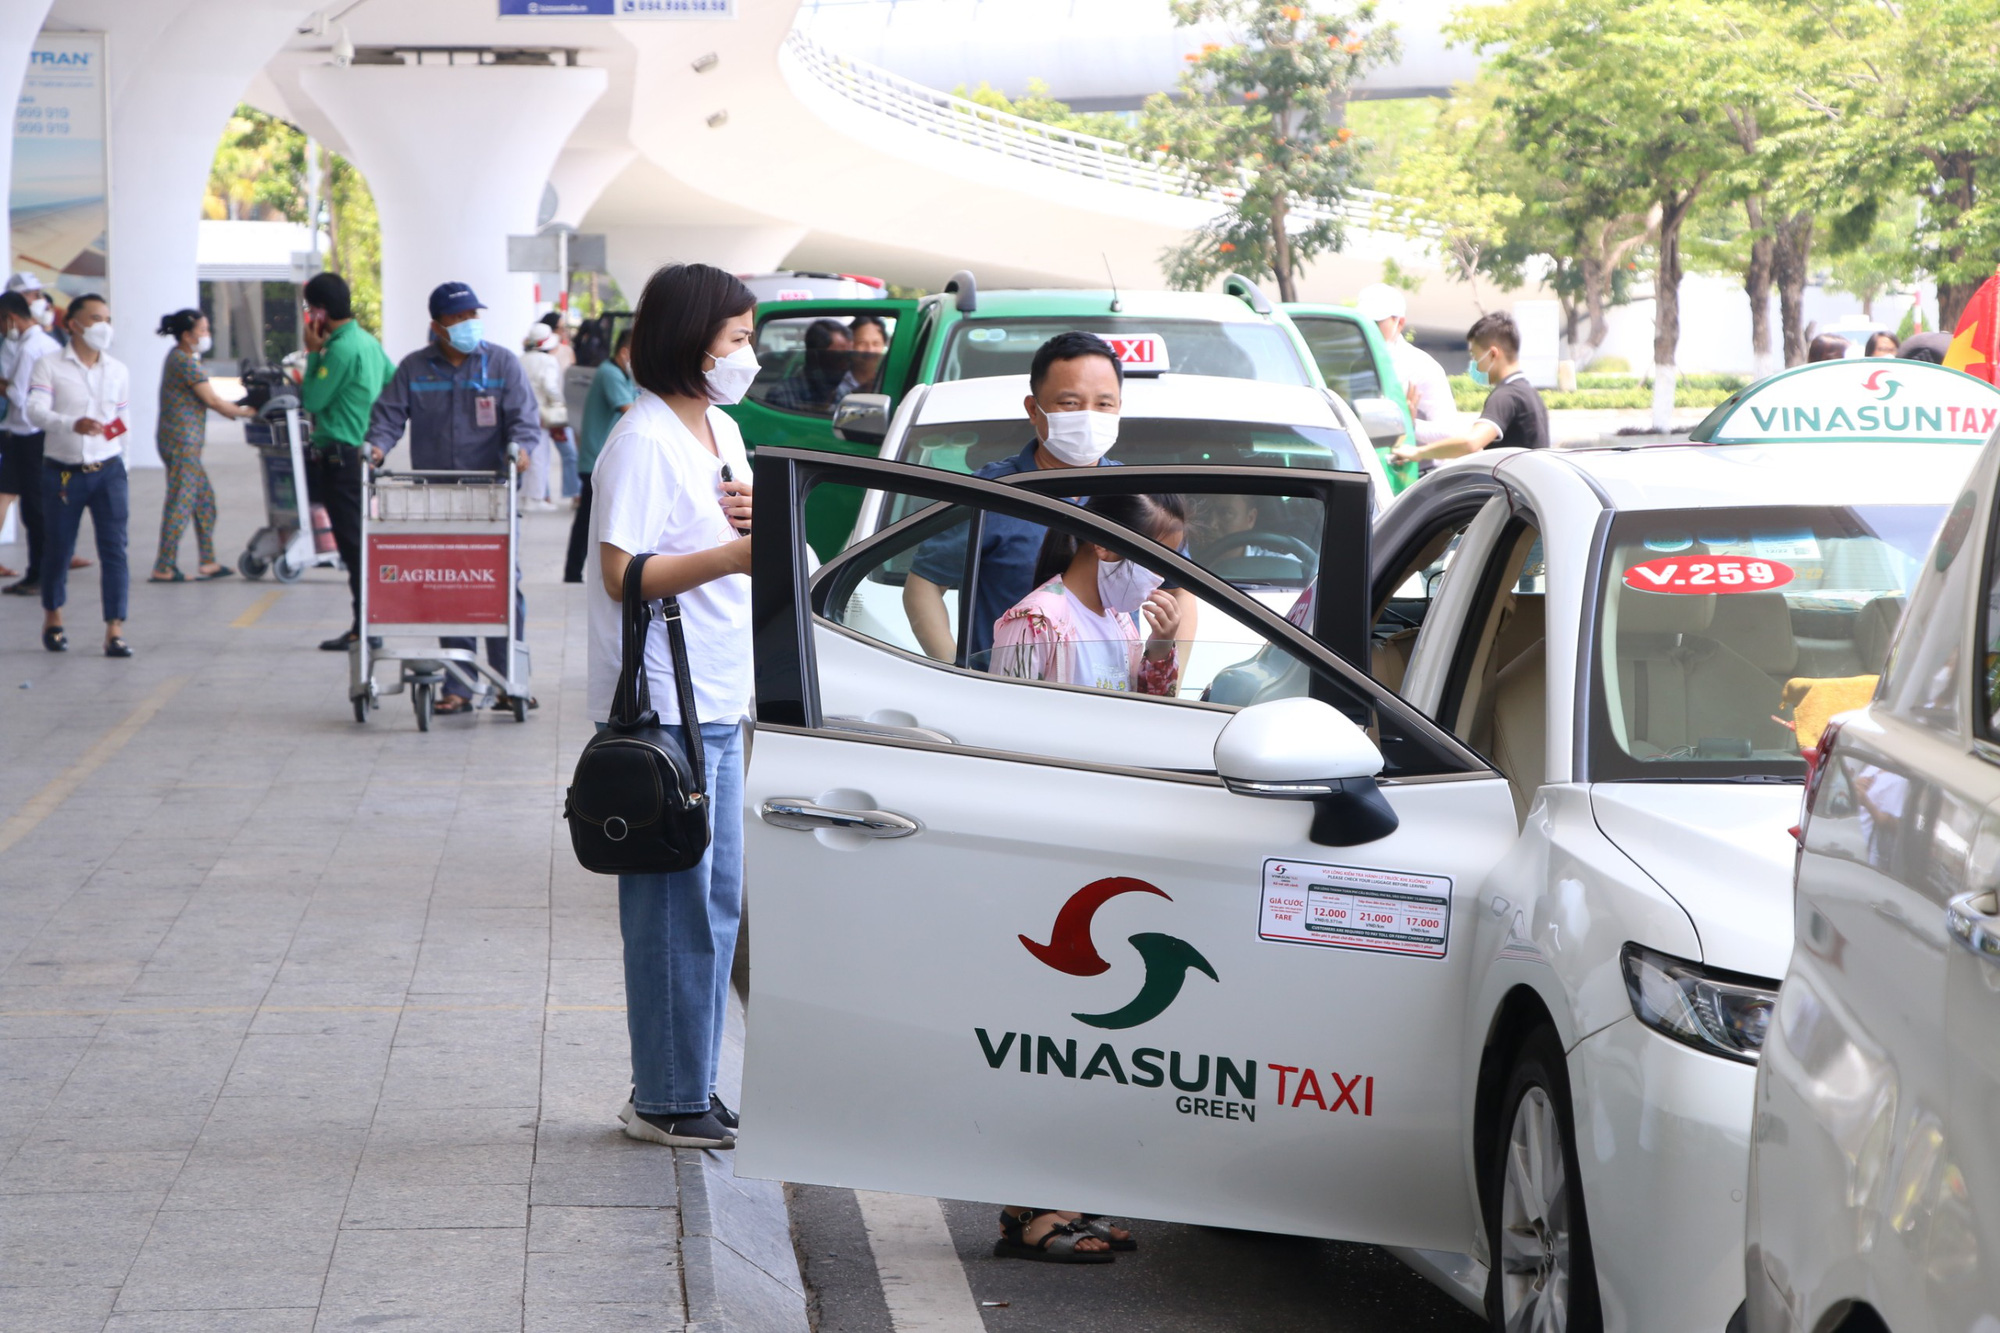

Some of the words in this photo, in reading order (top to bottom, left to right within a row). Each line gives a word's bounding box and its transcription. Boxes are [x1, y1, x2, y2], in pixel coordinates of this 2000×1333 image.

[31, 51, 88, 64] TRAN
[1750, 406, 1942, 432] VINASUN
[400, 568, 497, 582] AGRIBANK
[1634, 562, 1775, 585] V.259
[1314, 908, 1346, 918] 12.000
[1360, 912, 1393, 923] 21.000
[1406, 917, 1439, 928] 17.000
[974, 1028, 1257, 1100] VINASUN
[1268, 1064, 1373, 1116] TAXI
[1176, 1096, 1256, 1122] GREEN
